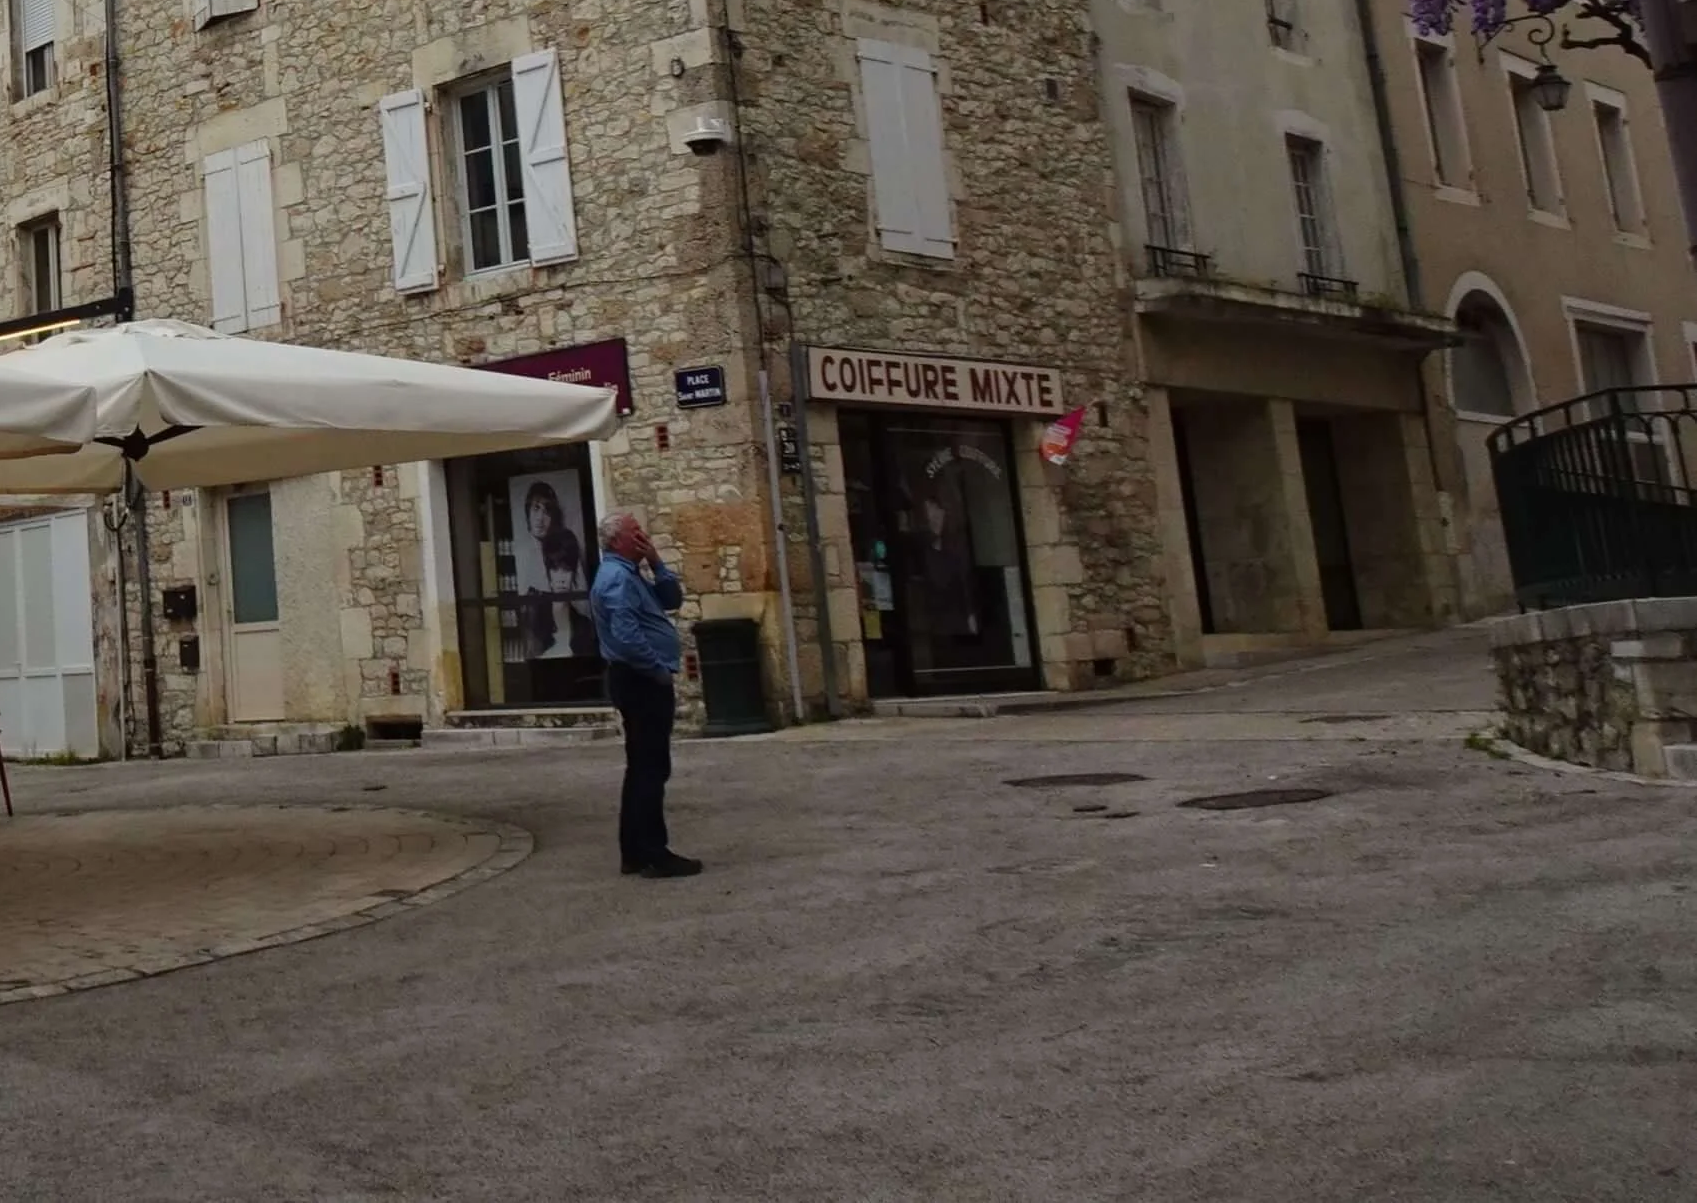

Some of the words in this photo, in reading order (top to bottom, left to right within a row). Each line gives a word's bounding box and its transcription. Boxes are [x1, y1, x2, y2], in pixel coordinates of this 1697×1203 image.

[686, 374, 710, 386] PLACE
[820, 354, 960, 401] COIFFURE
[969, 367, 1054, 408] MIXTE
